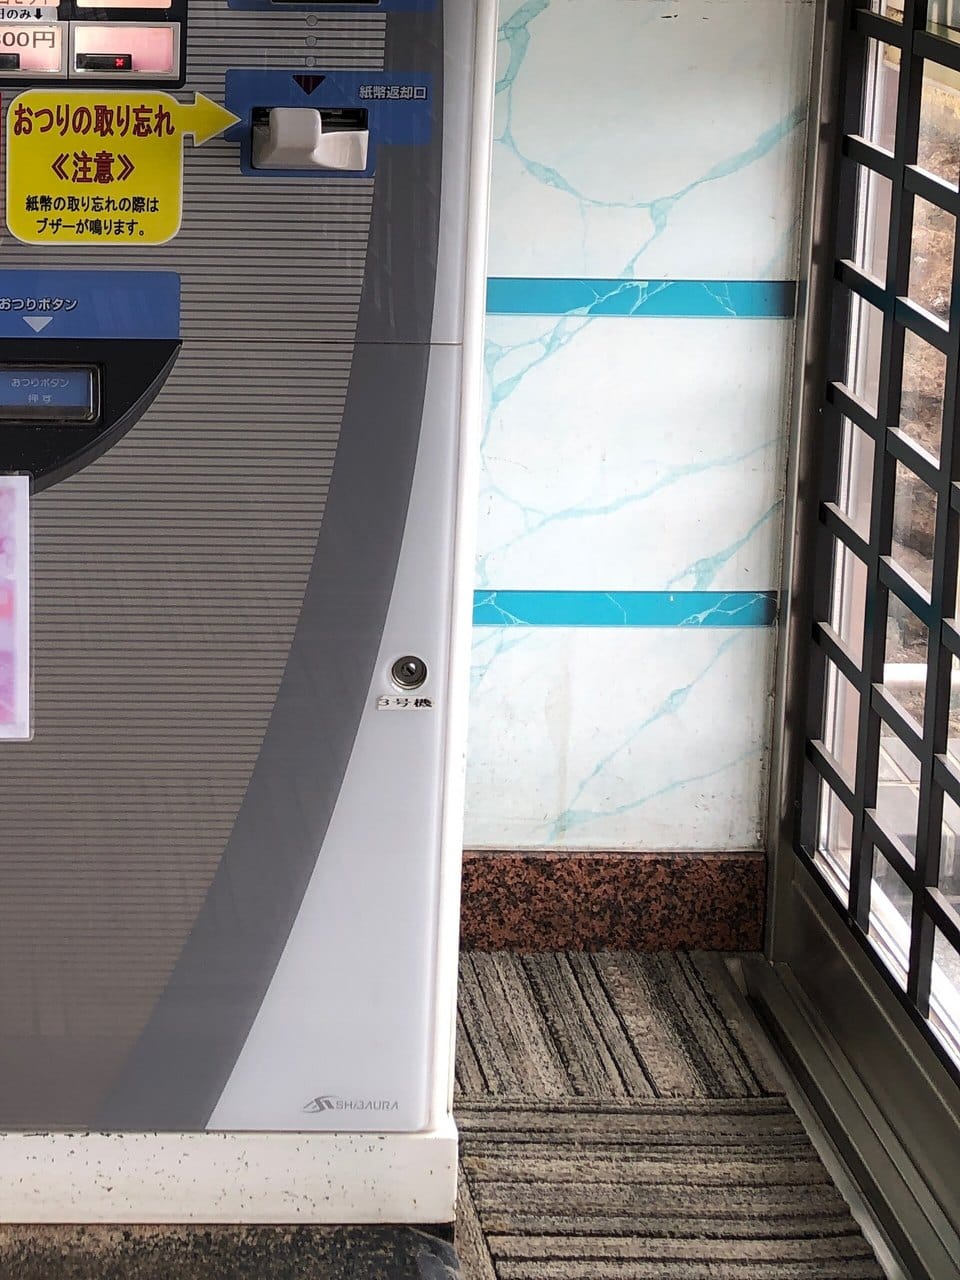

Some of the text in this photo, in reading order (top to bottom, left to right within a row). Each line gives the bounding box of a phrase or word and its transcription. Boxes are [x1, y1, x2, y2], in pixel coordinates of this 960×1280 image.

[358, 85, 428, 100] 紙幣返却口
[13, 103, 176, 138] おつりの取り忘れ
[25, 194, 160, 214] 紙幣の取り忘れの際は
[35, 217, 145, 237] ブザーが鳴ります。
